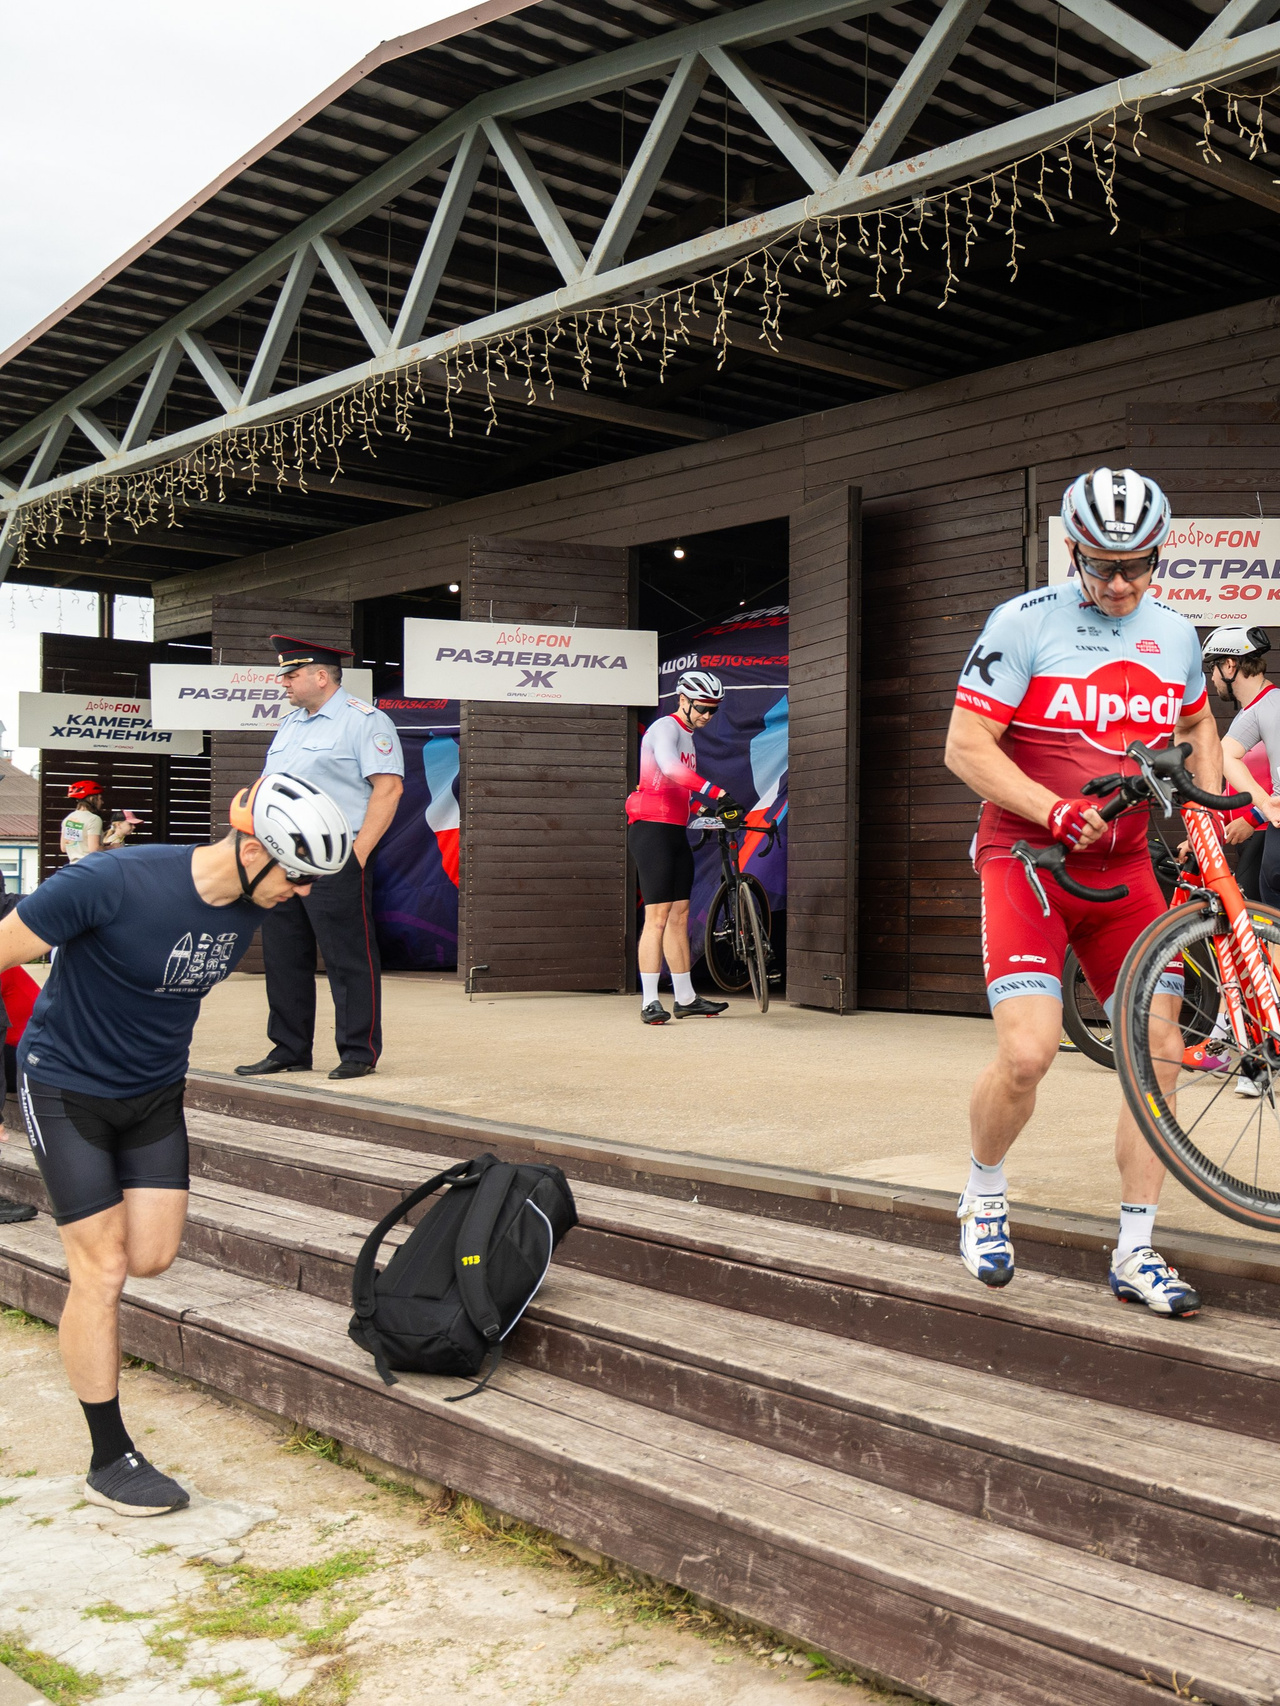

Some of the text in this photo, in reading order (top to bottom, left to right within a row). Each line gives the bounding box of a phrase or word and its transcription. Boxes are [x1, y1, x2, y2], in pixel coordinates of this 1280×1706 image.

[1218, 584, 1263, 600] 30
[1020, 593, 1058, 611] ARETI
[435, 647, 628, 670] РАЗДЕВАЛКА
[700, 654, 789, 668] ВЕЛОЗАЕЗ
[516, 669, 558, 689] Ж
[178, 687, 291, 702] РАЗДЕВА
[252, 704, 281, 718] М
[49, 726, 173, 743] ХРАНЕНИЯ
[1233, 908, 1274, 1010] CANYON
[994, 980, 1047, 994] CANYON
[461, 1255, 481, 1266] 113
